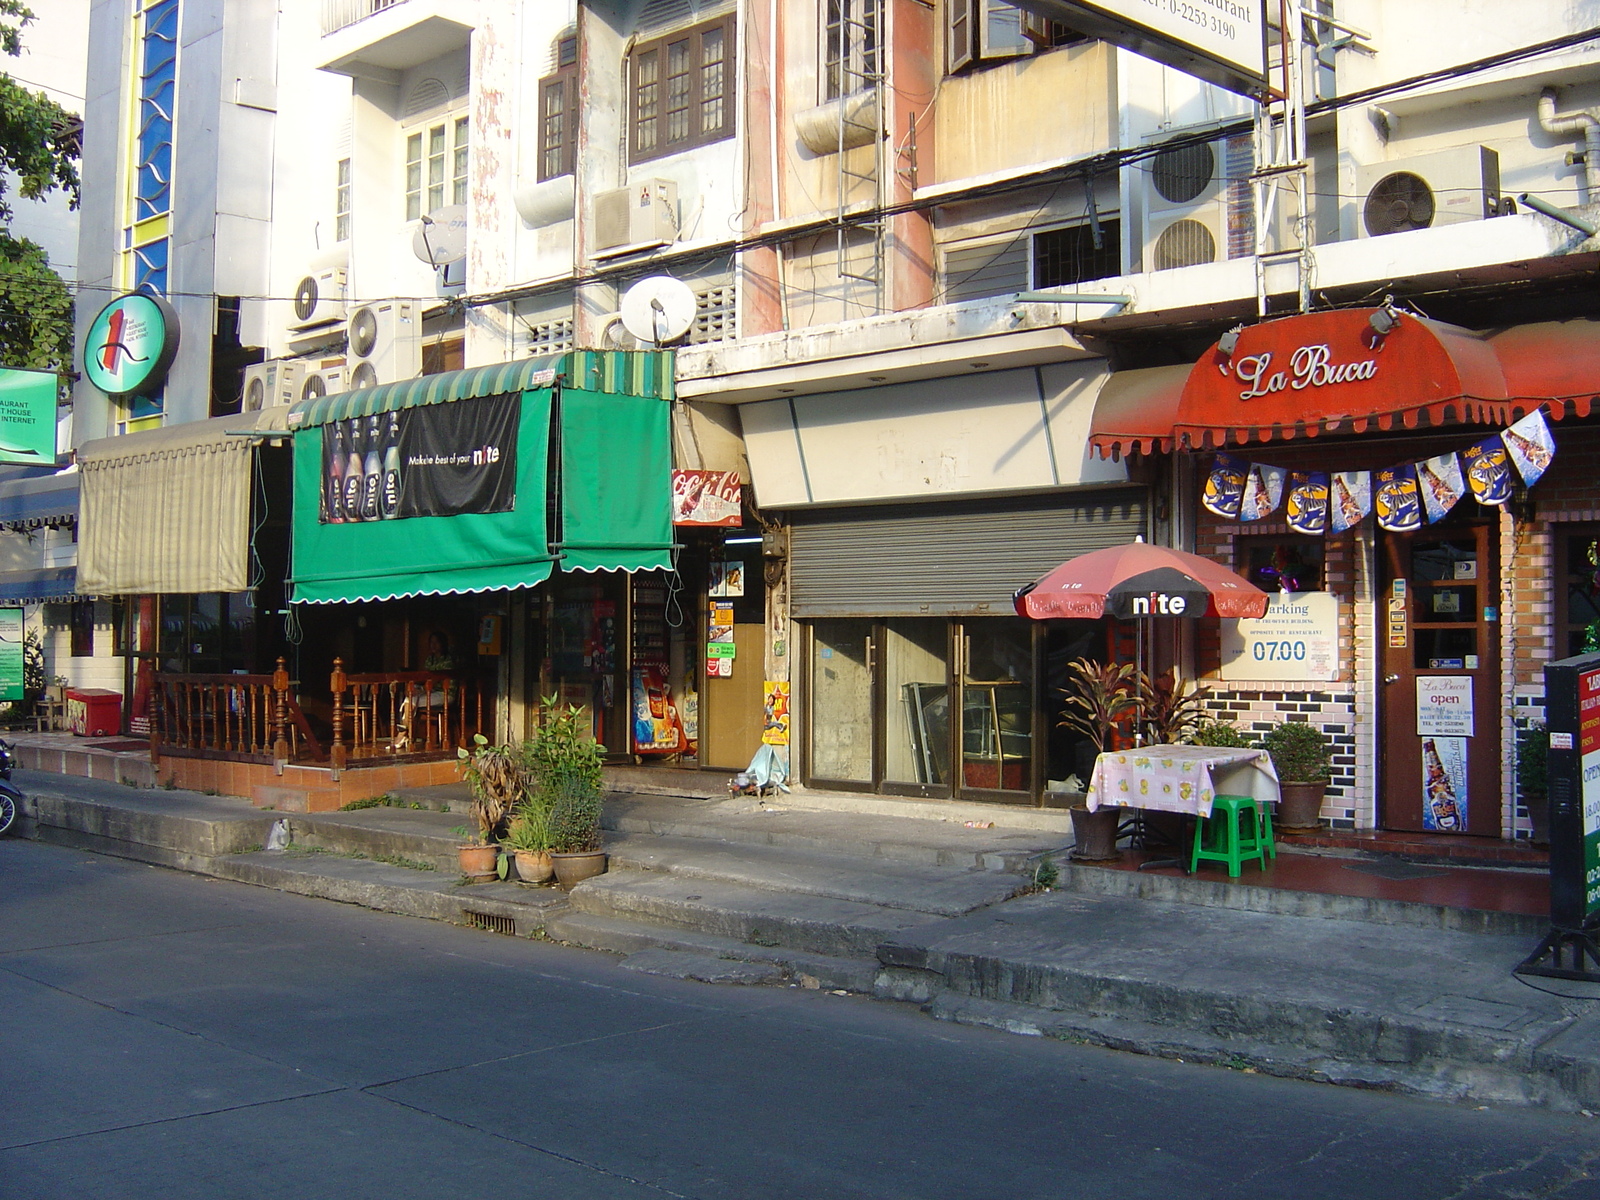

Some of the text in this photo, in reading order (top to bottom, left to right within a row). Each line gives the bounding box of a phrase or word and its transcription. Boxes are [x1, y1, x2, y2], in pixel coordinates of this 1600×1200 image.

[1210, 16, 1236, 41] 3190
[1236, 344, 1378, 400] La Buca
[7, 408, 32, 416] HOUSE
[473, 445, 500, 466] nite
[1132, 591, 1186, 615] nite
[1269, 603, 1310, 617] arking
[1253, 641, 1306, 661] 07.00
[1430, 695, 1459, 705] open
